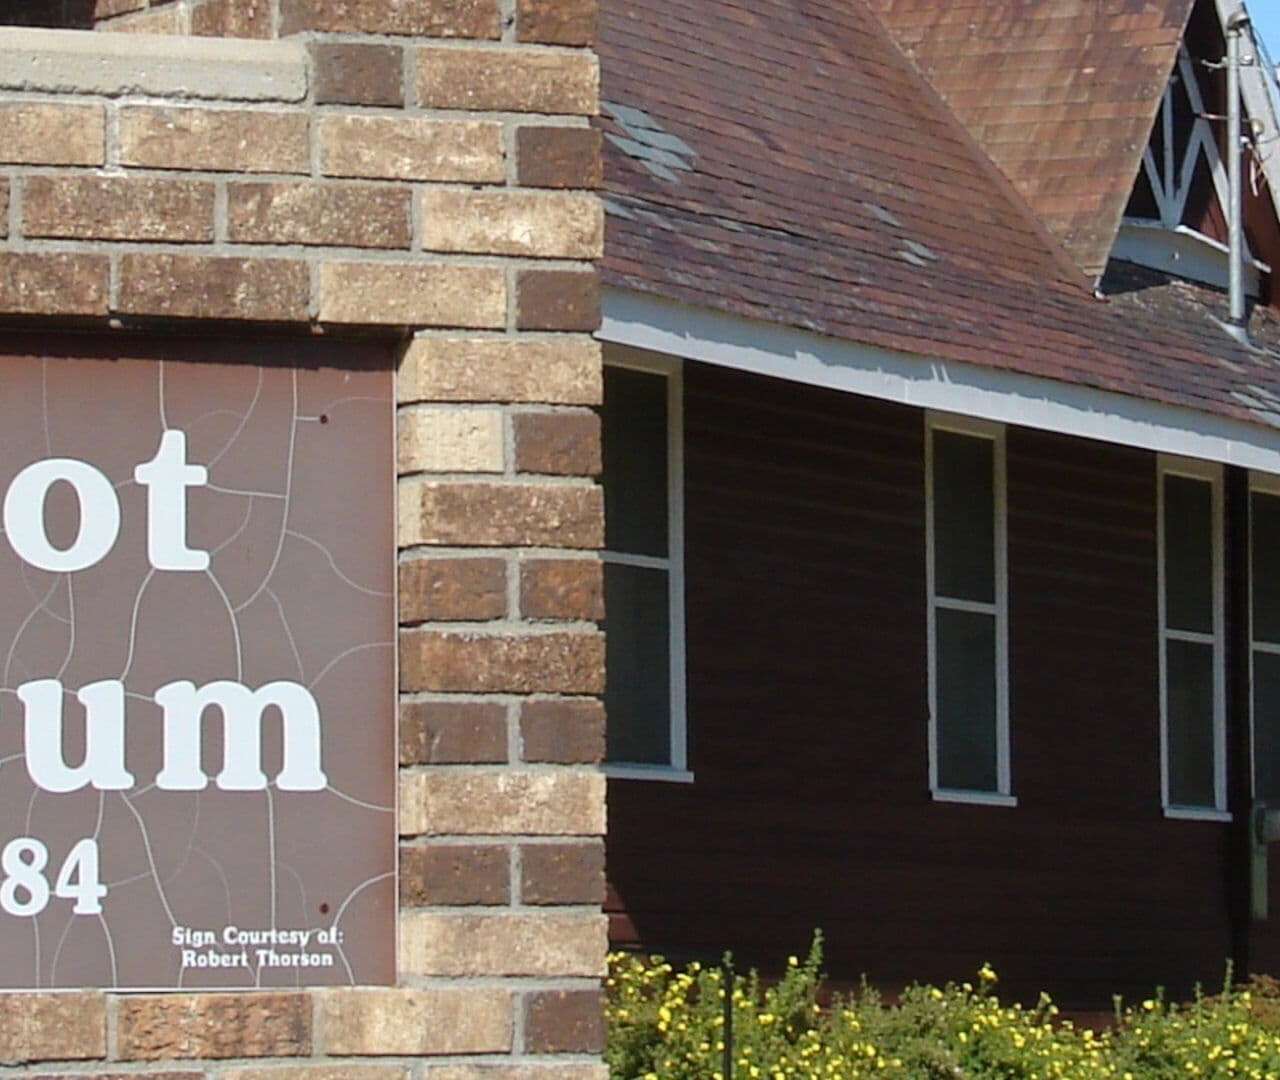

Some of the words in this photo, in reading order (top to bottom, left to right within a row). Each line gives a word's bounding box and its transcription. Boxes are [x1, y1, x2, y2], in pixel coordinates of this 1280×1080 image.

[172, 926, 216, 947] Sign
[223, 926, 309, 947] Courtesy
[317, 927, 344, 944] of:
[182, 950, 247, 967] Robert
[256, 950, 333, 966] Thorson
